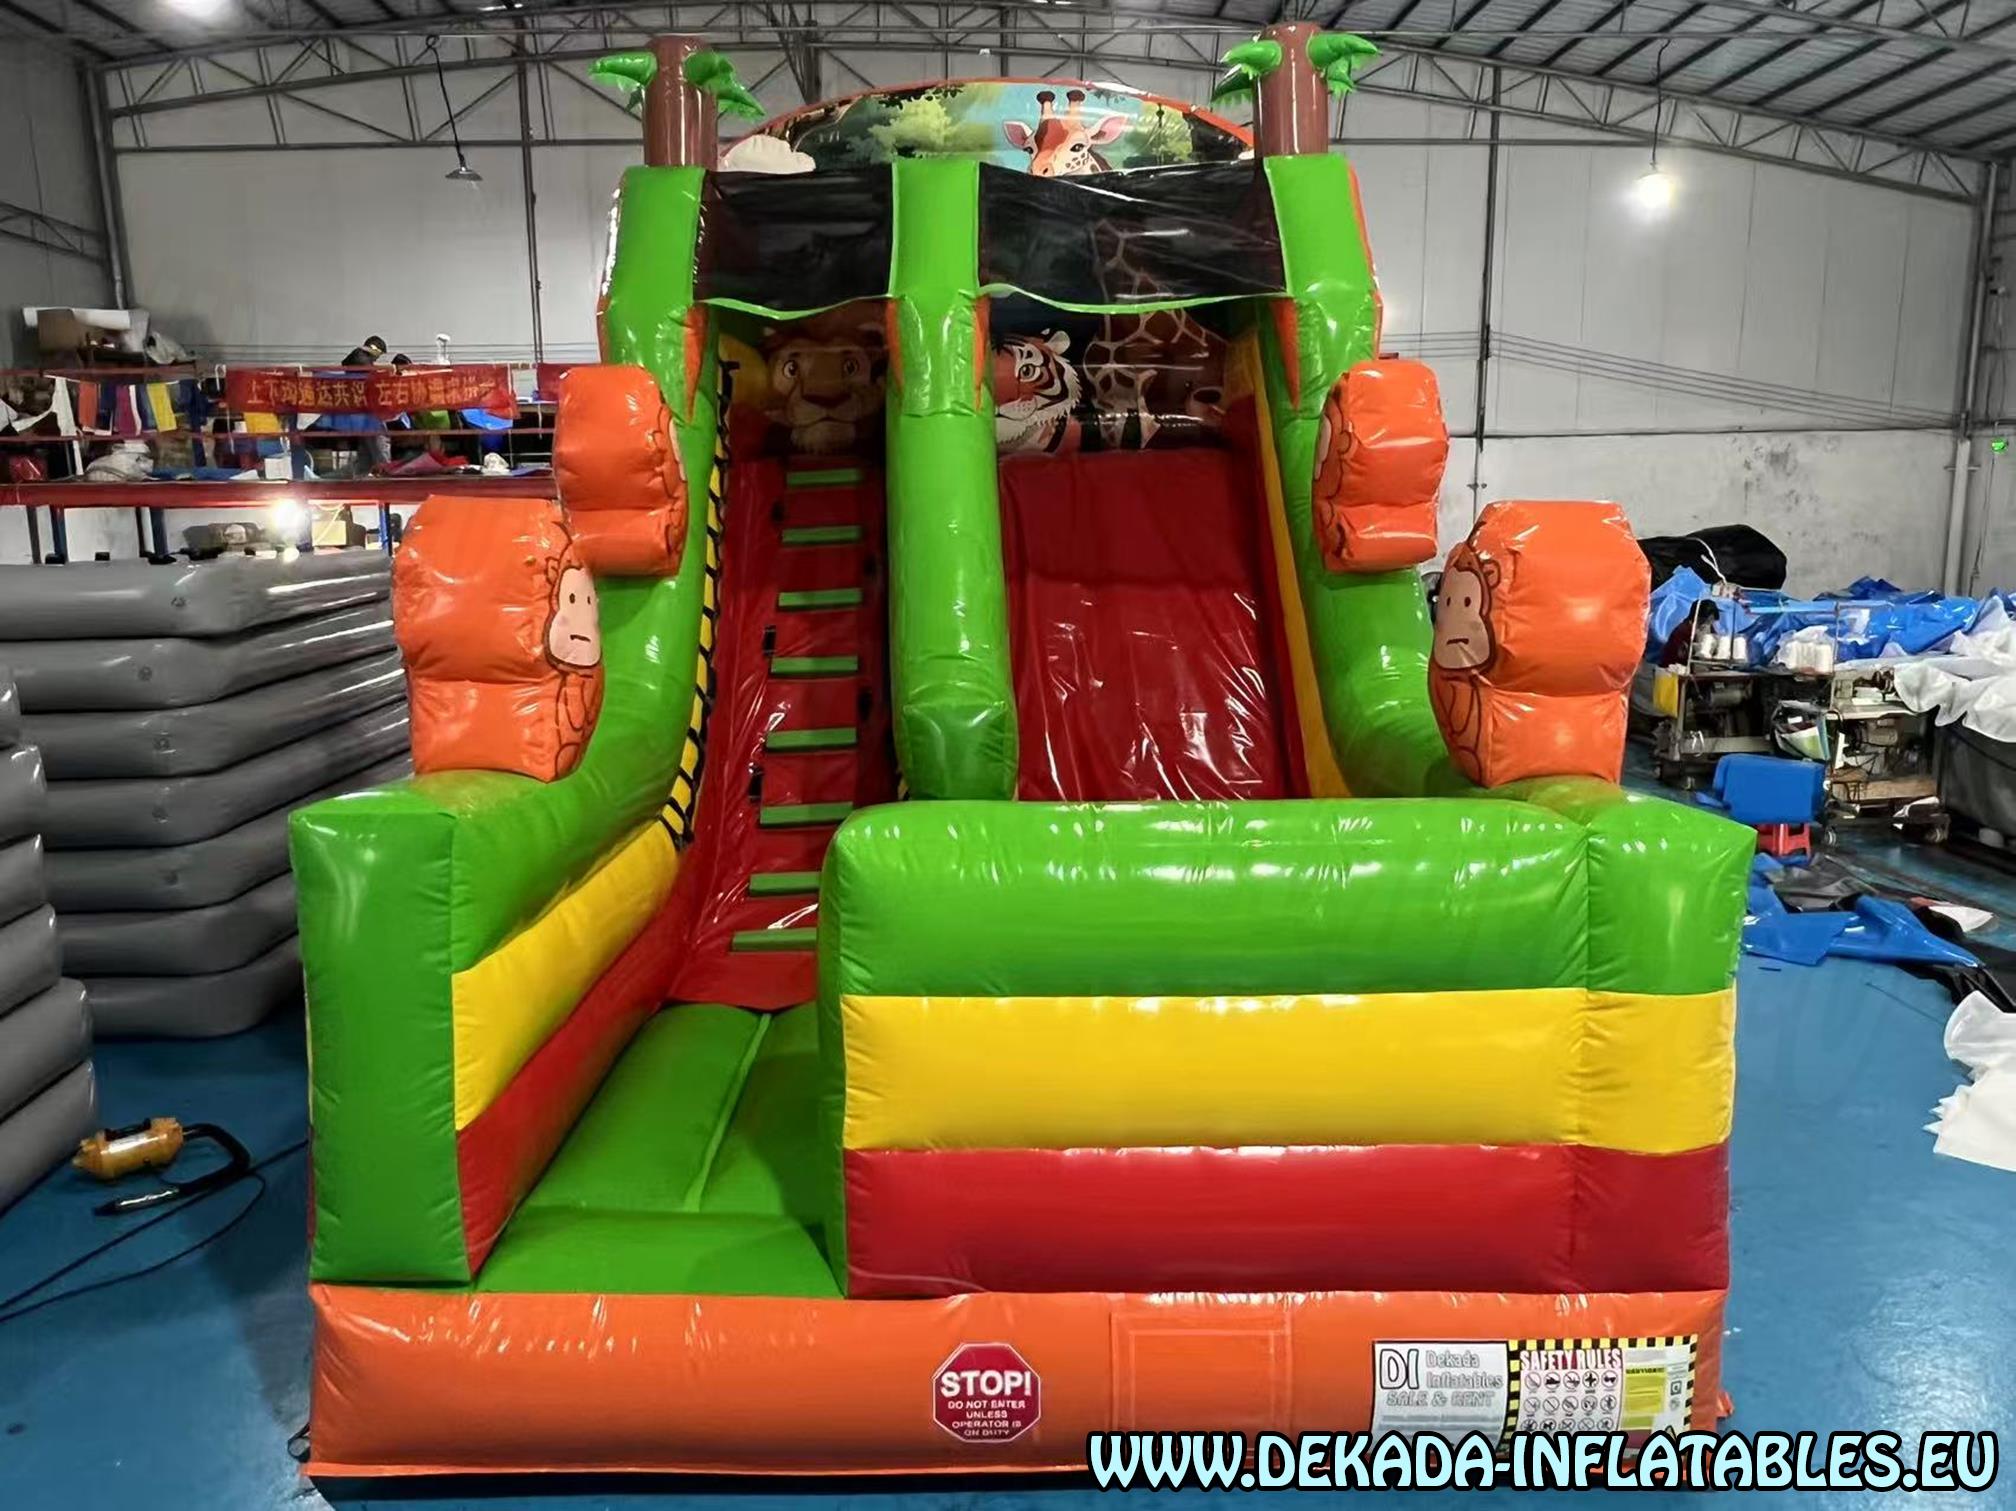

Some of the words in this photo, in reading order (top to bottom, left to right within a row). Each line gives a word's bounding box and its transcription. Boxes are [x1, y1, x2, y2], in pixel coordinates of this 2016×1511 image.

[1425, 1349, 1480, 1369] Dekada
[1520, 1349, 1573, 1371] SAFETY
[1575, 1348, 1622, 1370] RULES
[1379, 1348, 1420, 1390] DI
[941, 1371, 1031, 1397] STOP!
[1425, 1371, 1504, 1390] Inflatables
[948, 1400, 963, 1409] DO
[965, 1400, 987, 1409] NOT
[990, 1400, 1026, 1409] ENTER
[1386, 1390, 1429, 1407] SALE
[1431, 1390, 1448, 1407] &
[1450, 1390, 1496, 1407] RENT
[965, 1410, 1008, 1419] UNLESS
[951, 1420, 1009, 1429] OPERATOR
